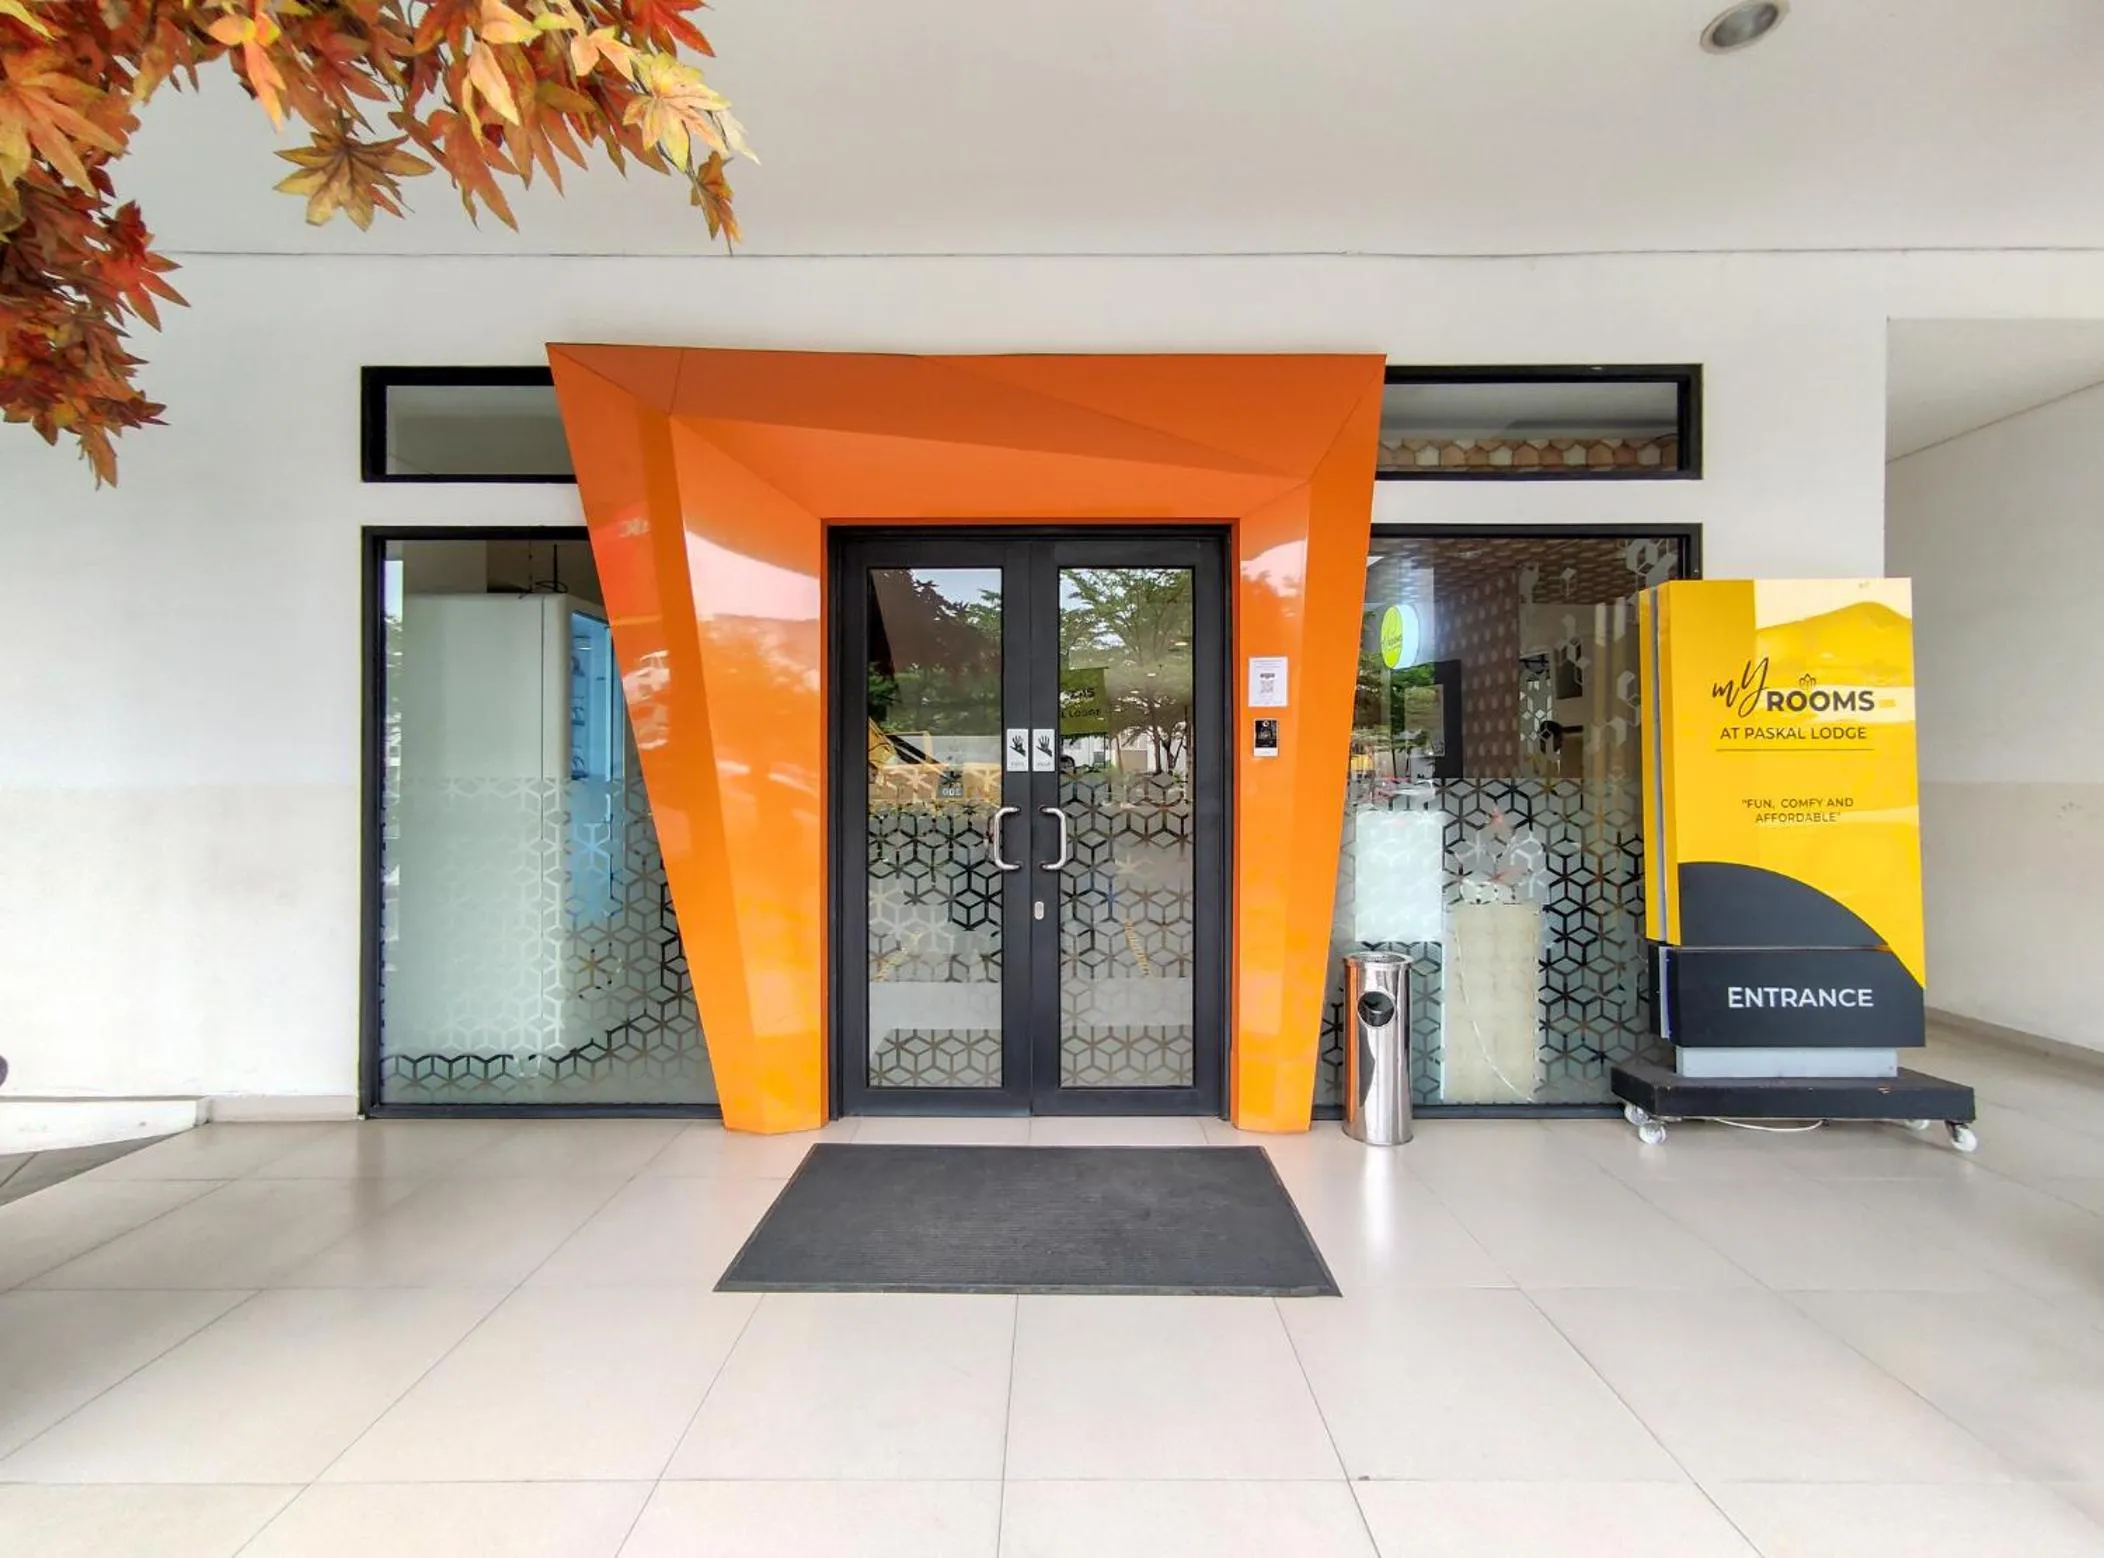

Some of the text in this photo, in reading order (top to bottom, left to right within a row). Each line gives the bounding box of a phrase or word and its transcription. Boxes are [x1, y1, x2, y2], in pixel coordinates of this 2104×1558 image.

[1766, 690, 1875, 712] ROOMS
[1720, 727, 1867, 740] AT PASKAL LODGE
[1780, 798, 1823, 809] COMFY
[1827, 797, 1854, 808] AND
[1727, 986, 1875, 1009] ENTRANCE
